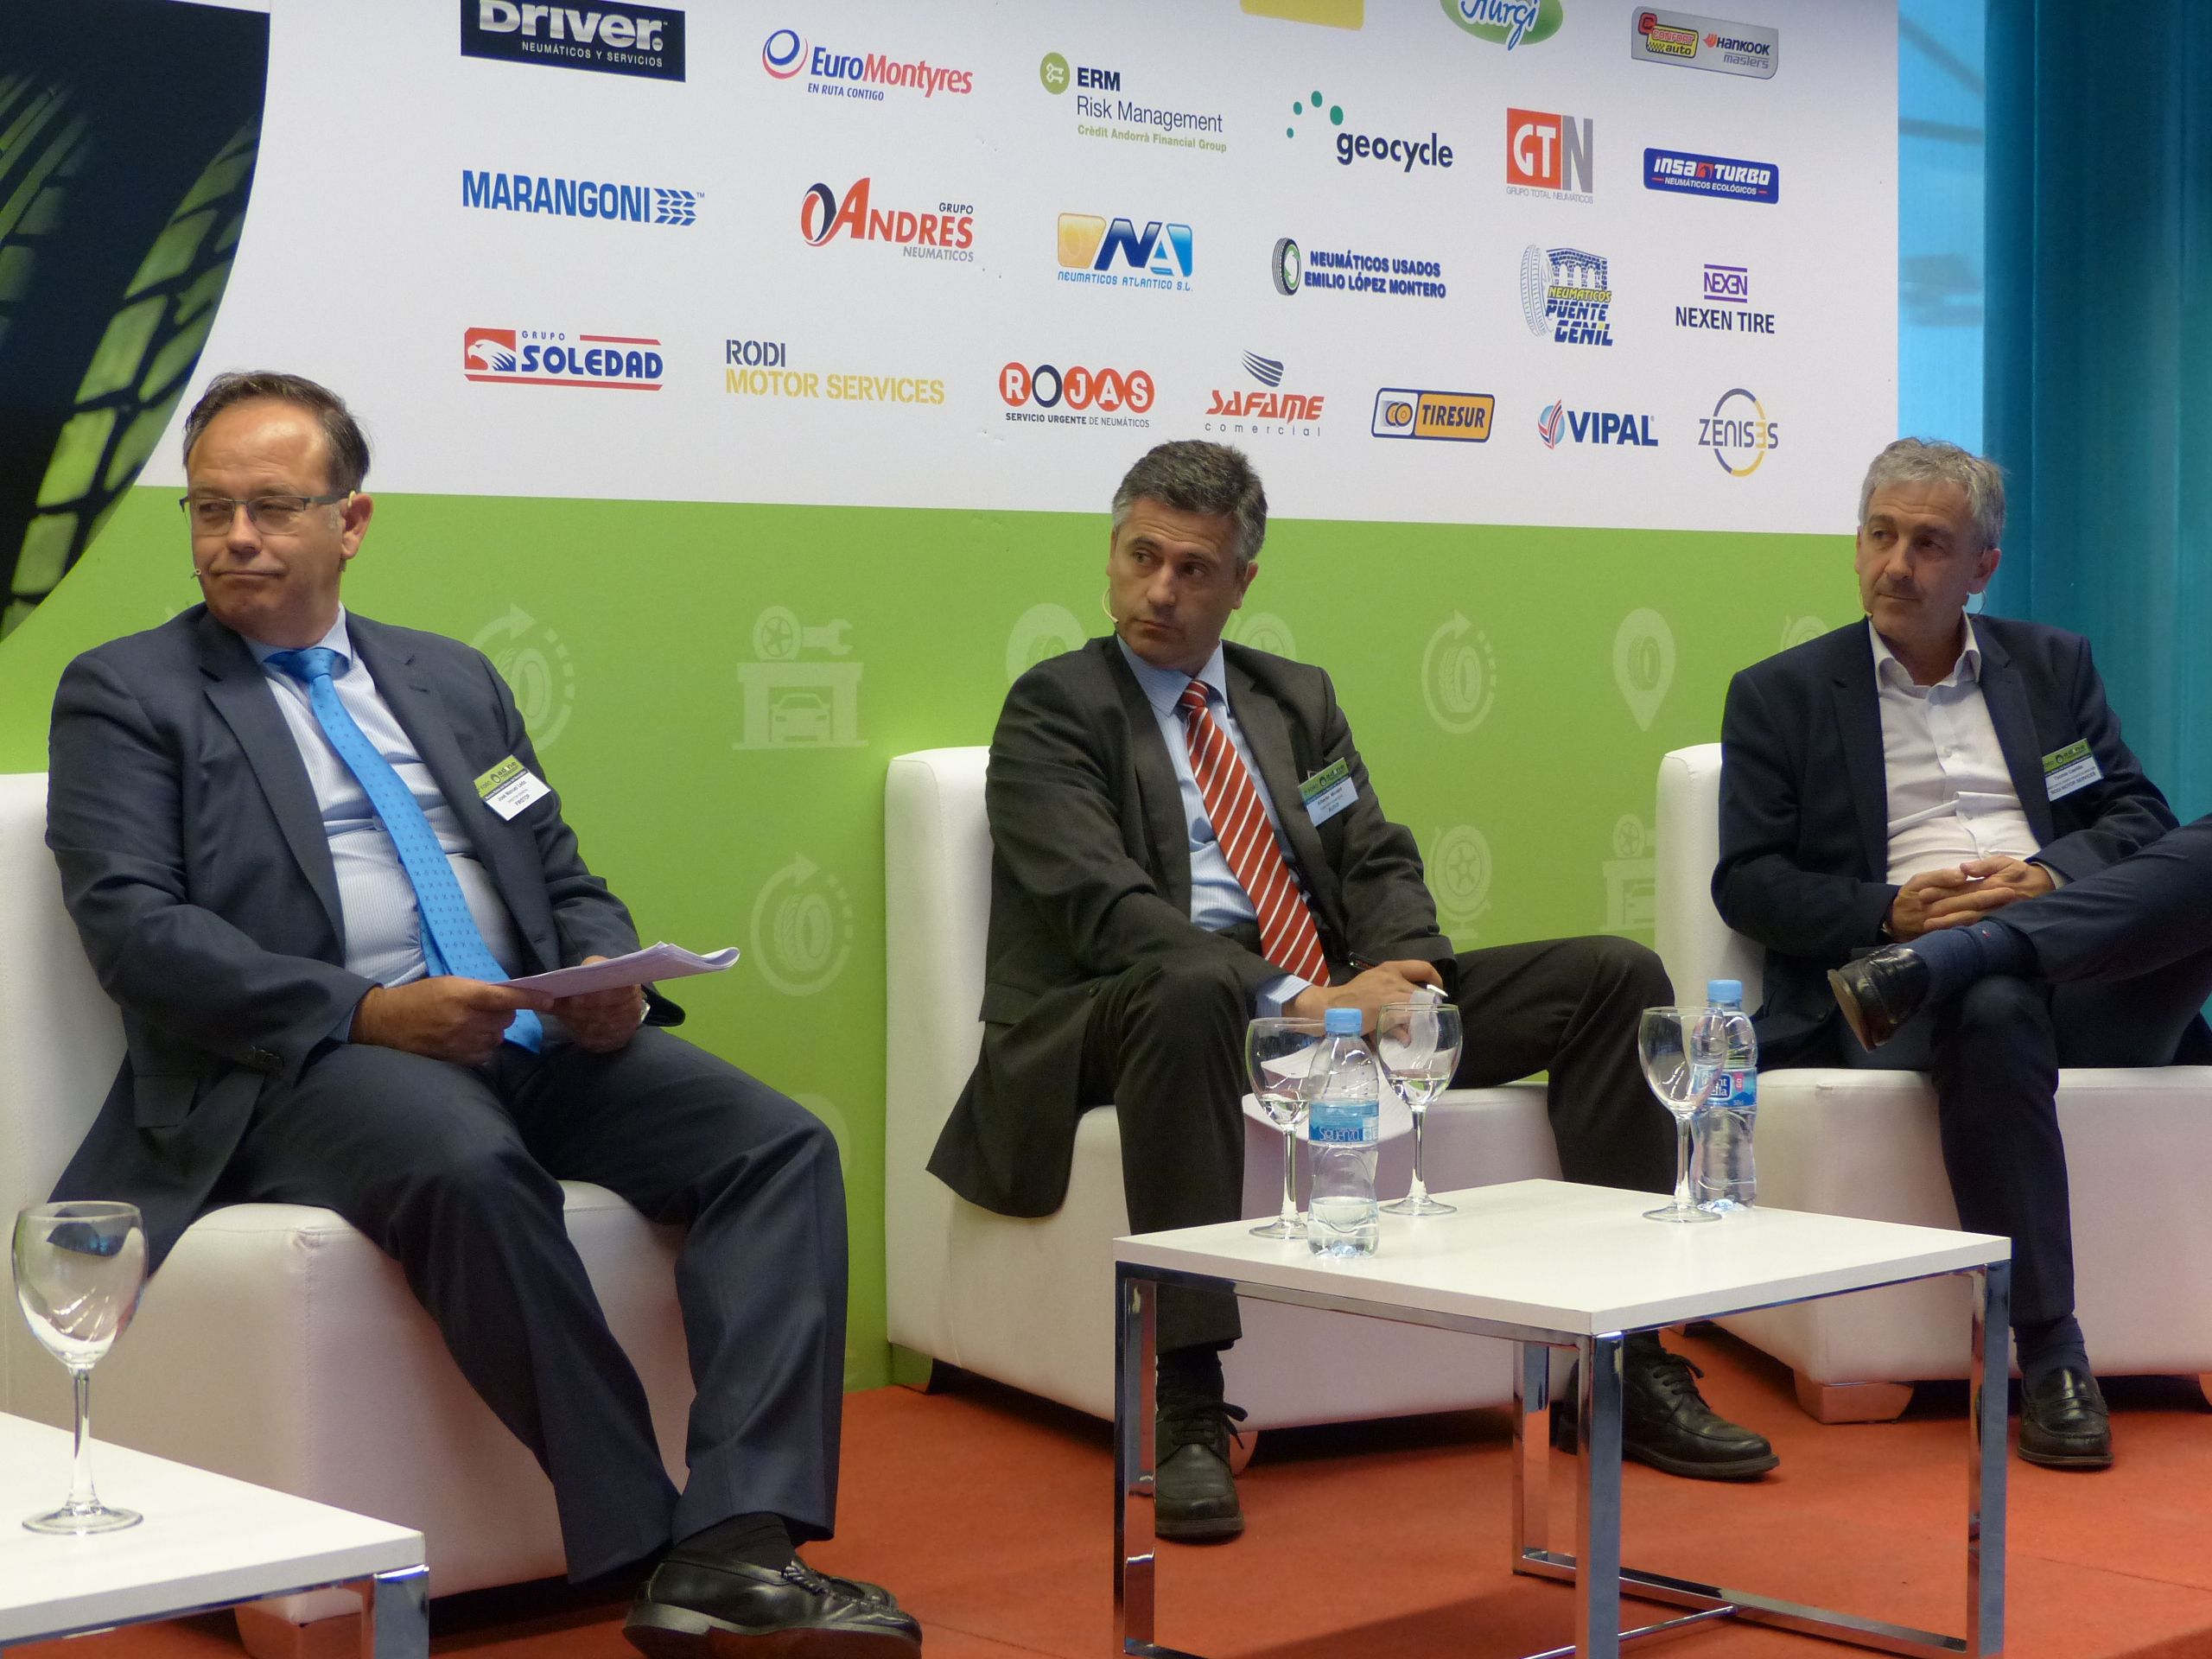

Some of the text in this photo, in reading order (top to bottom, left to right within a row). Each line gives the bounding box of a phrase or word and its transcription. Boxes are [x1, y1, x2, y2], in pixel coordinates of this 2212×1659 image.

[1652, 29, 1694, 46] CONFORT
[1666, 46, 1692, 55] auto
[522, 41, 663, 67] NEUMÁTICOS Y SERVICIOS
[1724, 54, 1769, 68] masters
[810, 47, 973, 98] EuroMontyres
[1077, 67, 1121, 92] ERM
[808, 83, 884, 101] EN RUTA CONTIGO
[1077, 95, 1223, 132] Risk Management
[1077, 124, 1227, 154] Crèdit Andorrà Financial Group
[1337, 132, 1453, 173] geocycle
[462, 170, 650, 223] MARANGONI
[1507, 187, 1529, 196] GRUPO
[1530, 189, 1552, 199] TOTAL
[1665, 177, 1757, 195] NEUMÁTICOS ECOLÓGICOS
[819, 177, 974, 249] ANDRES
[939, 202, 974, 214] GRUPO
[903, 245, 974, 262] NEUMATICOS
[1310, 250, 1440, 277] NEUMÁTICOS USADOS
[1058, 270, 1117, 285] NEUMATICOS
[1122, 276, 1173, 289] ATLANTICO
[1305, 271, 1446, 298] EMILIO LÓPEZ MONTERO
[1545, 299, 1609, 321] PUENTE
[1676, 306, 1775, 334] NEXEN TIRE
[522, 330, 565, 340] GRUPO
[521, 345, 663, 379] SOLEDAD
[726, 339, 785, 367] RODI
[726, 368, 944, 404] MOTOR SERVICES
[1001, 364, 1153, 411] ROJAS
[1006, 412, 1149, 428] SERVICIO URGENTE DE NEUMÁTICOS
[1205, 390, 1325, 424] SAFAME
[1422, 404, 1485, 428] TIRESUR
[1205, 422, 1320, 436] comercial
[1567, 410, 1658, 447] VIPAL
